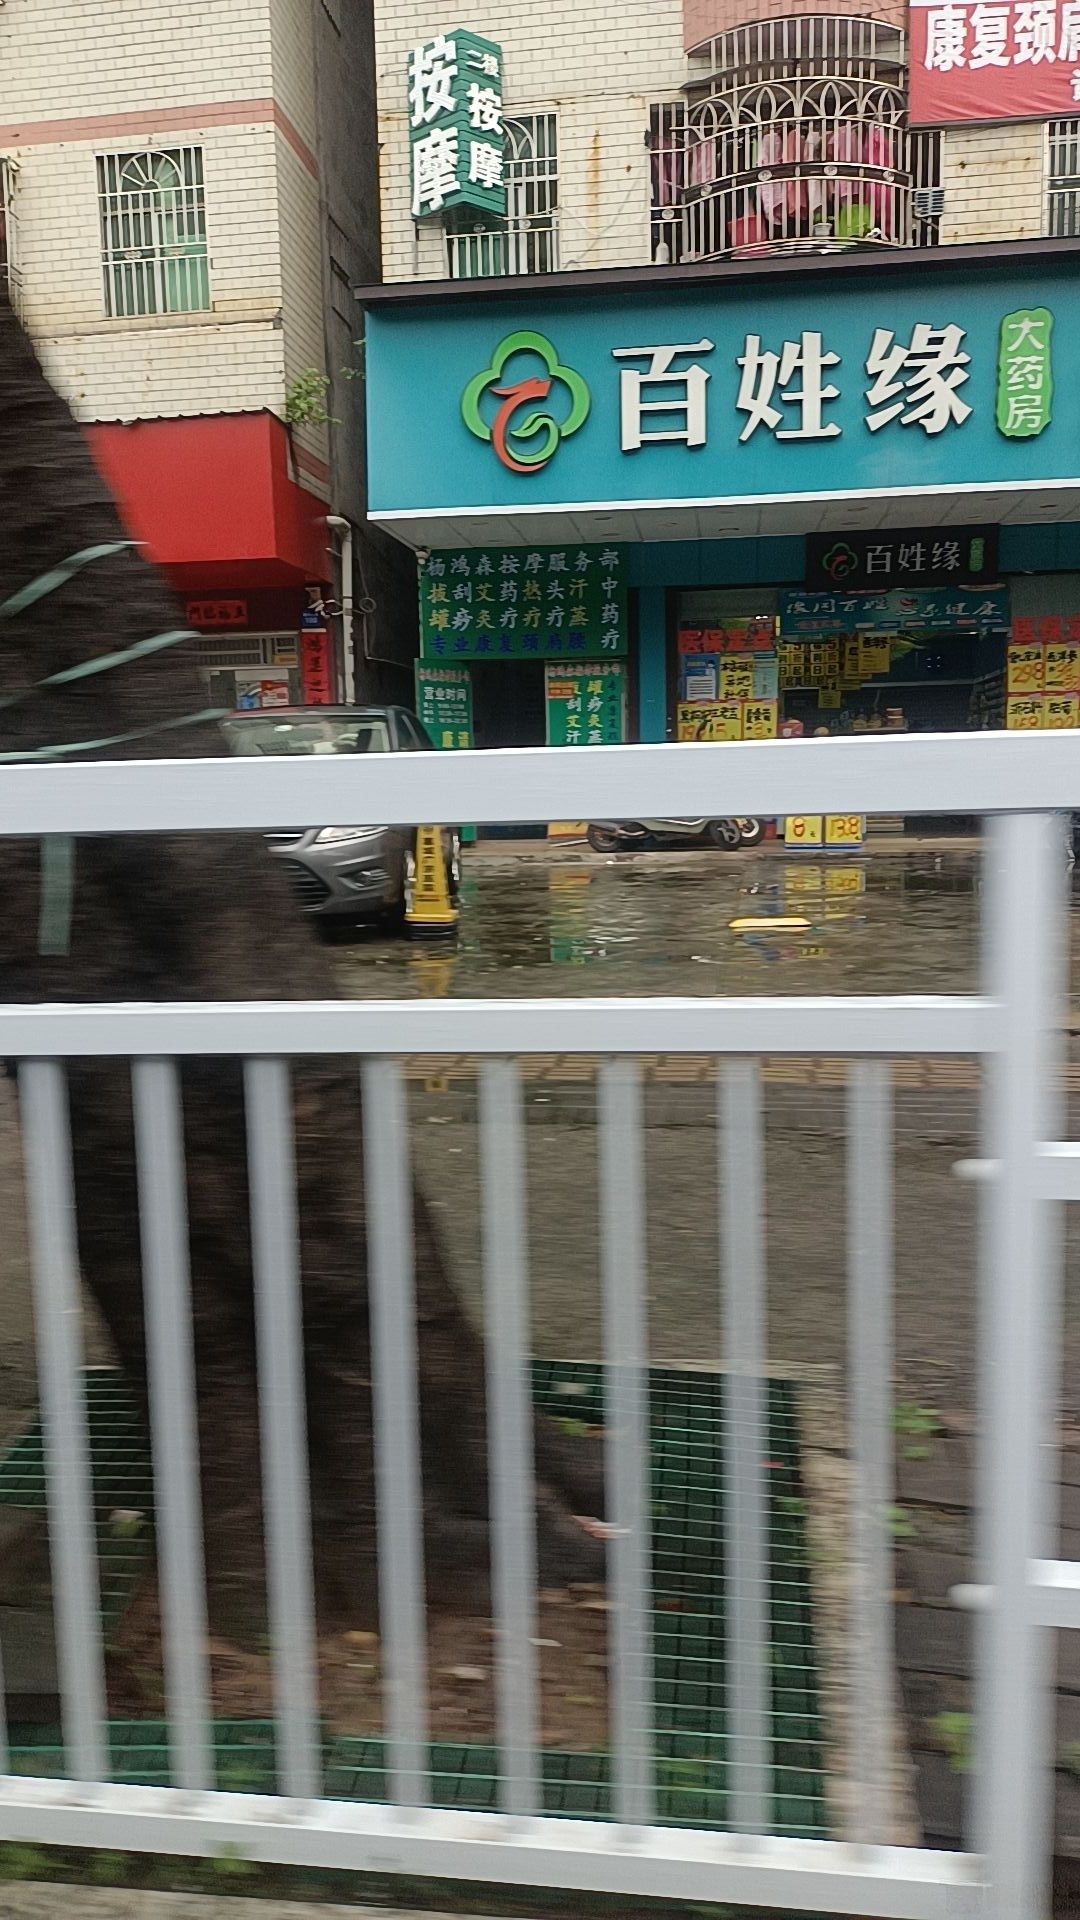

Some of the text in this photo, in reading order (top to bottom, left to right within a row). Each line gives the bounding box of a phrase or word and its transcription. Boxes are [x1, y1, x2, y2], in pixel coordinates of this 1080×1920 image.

[466, 50, 499, 77] 二楼
[408, 35, 461, 217] 按摩
[467, 82, 503, 188] 按摩
[612, 322, 973, 451] 百姓缘
[1005, 317, 1045, 429] 大药房
[865, 541, 960, 574] 百姓缘
